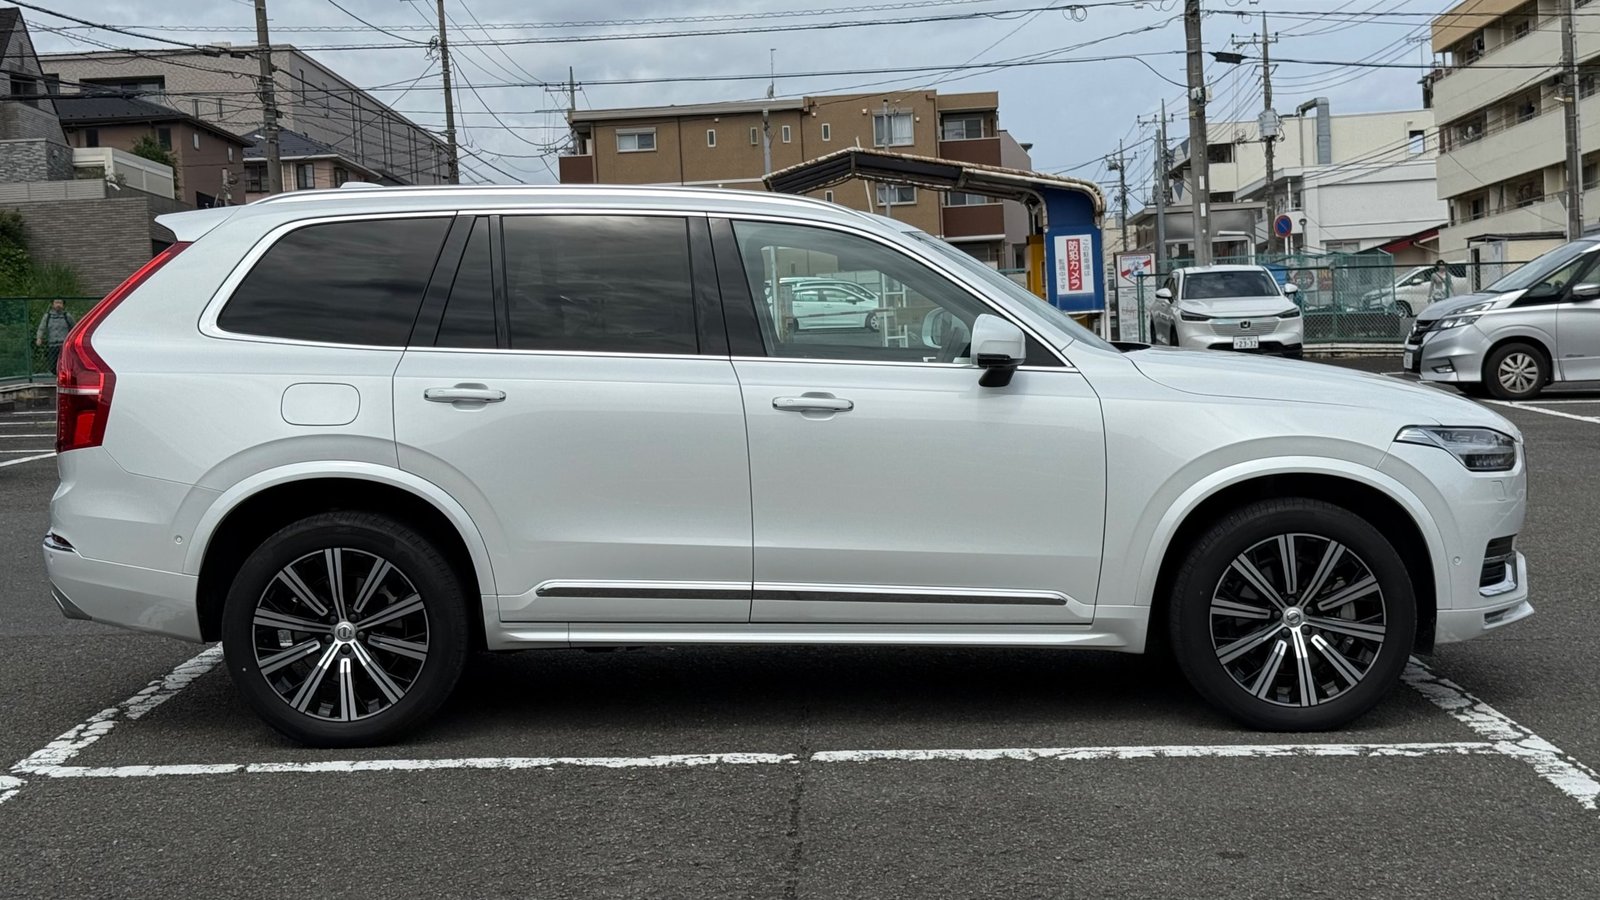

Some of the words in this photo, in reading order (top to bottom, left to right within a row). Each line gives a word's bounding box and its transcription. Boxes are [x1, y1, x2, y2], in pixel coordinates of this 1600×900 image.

[1068, 240, 1080, 289] 防犯カメラ
